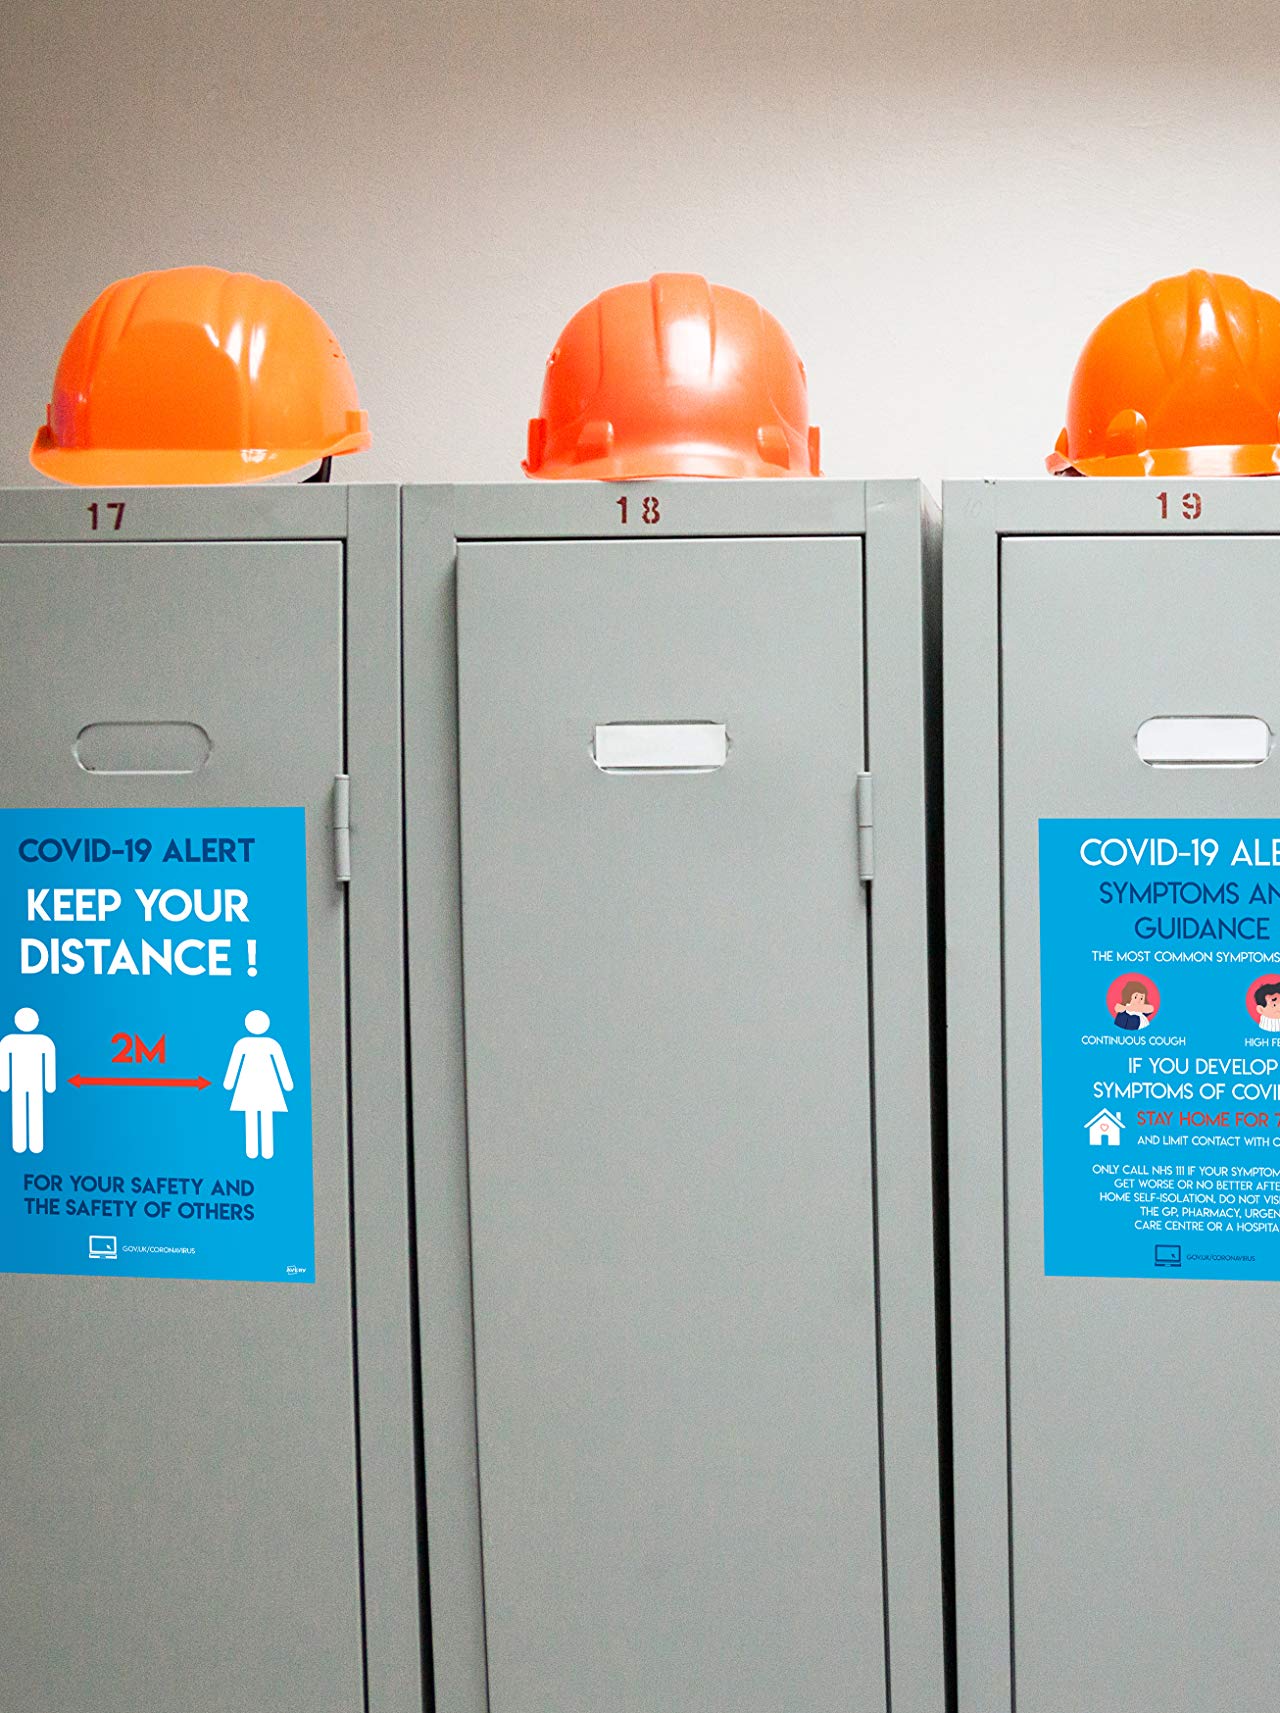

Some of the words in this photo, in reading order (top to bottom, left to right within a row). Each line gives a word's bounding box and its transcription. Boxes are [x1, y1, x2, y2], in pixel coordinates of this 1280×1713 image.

[87, 502, 125, 530] 17
[616, 496, 660, 524] 18
[1156, 492, 1201, 520] 19
[18, 838, 152, 863] COVID-19
[162, 838, 255, 862] ALERT
[1080, 838, 1219, 866] COVID-19
[1099, 881, 1239, 905] SYMPTOMS
[27, 888, 121, 921] KEEP
[135, 888, 250, 922] YOUR
[1134, 916, 1270, 940] GUIDANCE
[21, 938, 232, 976] DISTANCE
[1091, 950, 1113, 962] THE
[1116, 950, 1151, 962] MOST
[1154, 951, 1213, 962] COMMON
[1216, 951, 1280, 963] SYMPTOMS
[111, 1032, 166, 1064] 2M
[1081, 1035, 1146, 1046] CONTINUOUS
[1148, 1036, 1186, 1046] COUGH
[1245, 1037, 1269, 1047] HIGH
[1129, 1057, 1143, 1074] IF
[1148, 1057, 1189, 1075] YOU
[1196, 1058, 1278, 1075] DEVELOP
[1093, 1081, 1194, 1100] SYMPTOMS
[1199, 1083, 1226, 1100] OF
[1137, 1110, 1174, 1126] STAY
[1179, 1111, 1230, 1127] HOME
[1235, 1111, 1269, 1128] FOR
[1137, 1135, 1160, 1145] AND
[1162, 1135, 1189, 1146] LIMIT
[1191, 1135, 1241, 1147] CONTACT
[1244, 1136, 1270, 1147] WITH
[1092, 1164, 1120, 1175] ONLY
[1122, 1164, 1149, 1175] CALL
[1152, 1165, 1173, 1176] NHS
[1175, 1165, 1185, 1176] 111
[1187, 1165, 1196, 1176] IF
[1199, 1166, 1228, 1177] YOUR
[24, 1173, 63, 1192] FOR
[69, 1175, 125, 1193] YOUR
[131, 1177, 203, 1195] SAFETY
[211, 1180, 254, 1196] AND
[1114, 1178, 1135, 1188] GET
[1138, 1179, 1174, 1189] WORSE
[1177, 1179, 1193, 1189] OR
[1196, 1180, 1214, 1190] NO
[1216, 1180, 1253, 1190] BETTER
[1100, 1192, 1131, 1202] HOME
[1219, 1194, 1236, 1204] DO
[1238, 1194, 1260, 1204] NOT
[23, 1197, 60, 1215] THE
[65, 1199, 137, 1217] SAFETY
[144, 1201, 172, 1218] OF
[178, 1202, 254, 1221] OTHERS
[1140, 1206, 1159, 1216] THE
[1134, 1220, 1162, 1230] CARE
[1164, 1220, 1204, 1231] CENTRE
[1206, 1221, 1223, 1231] OR
[1226, 1222, 1234, 1232] A
